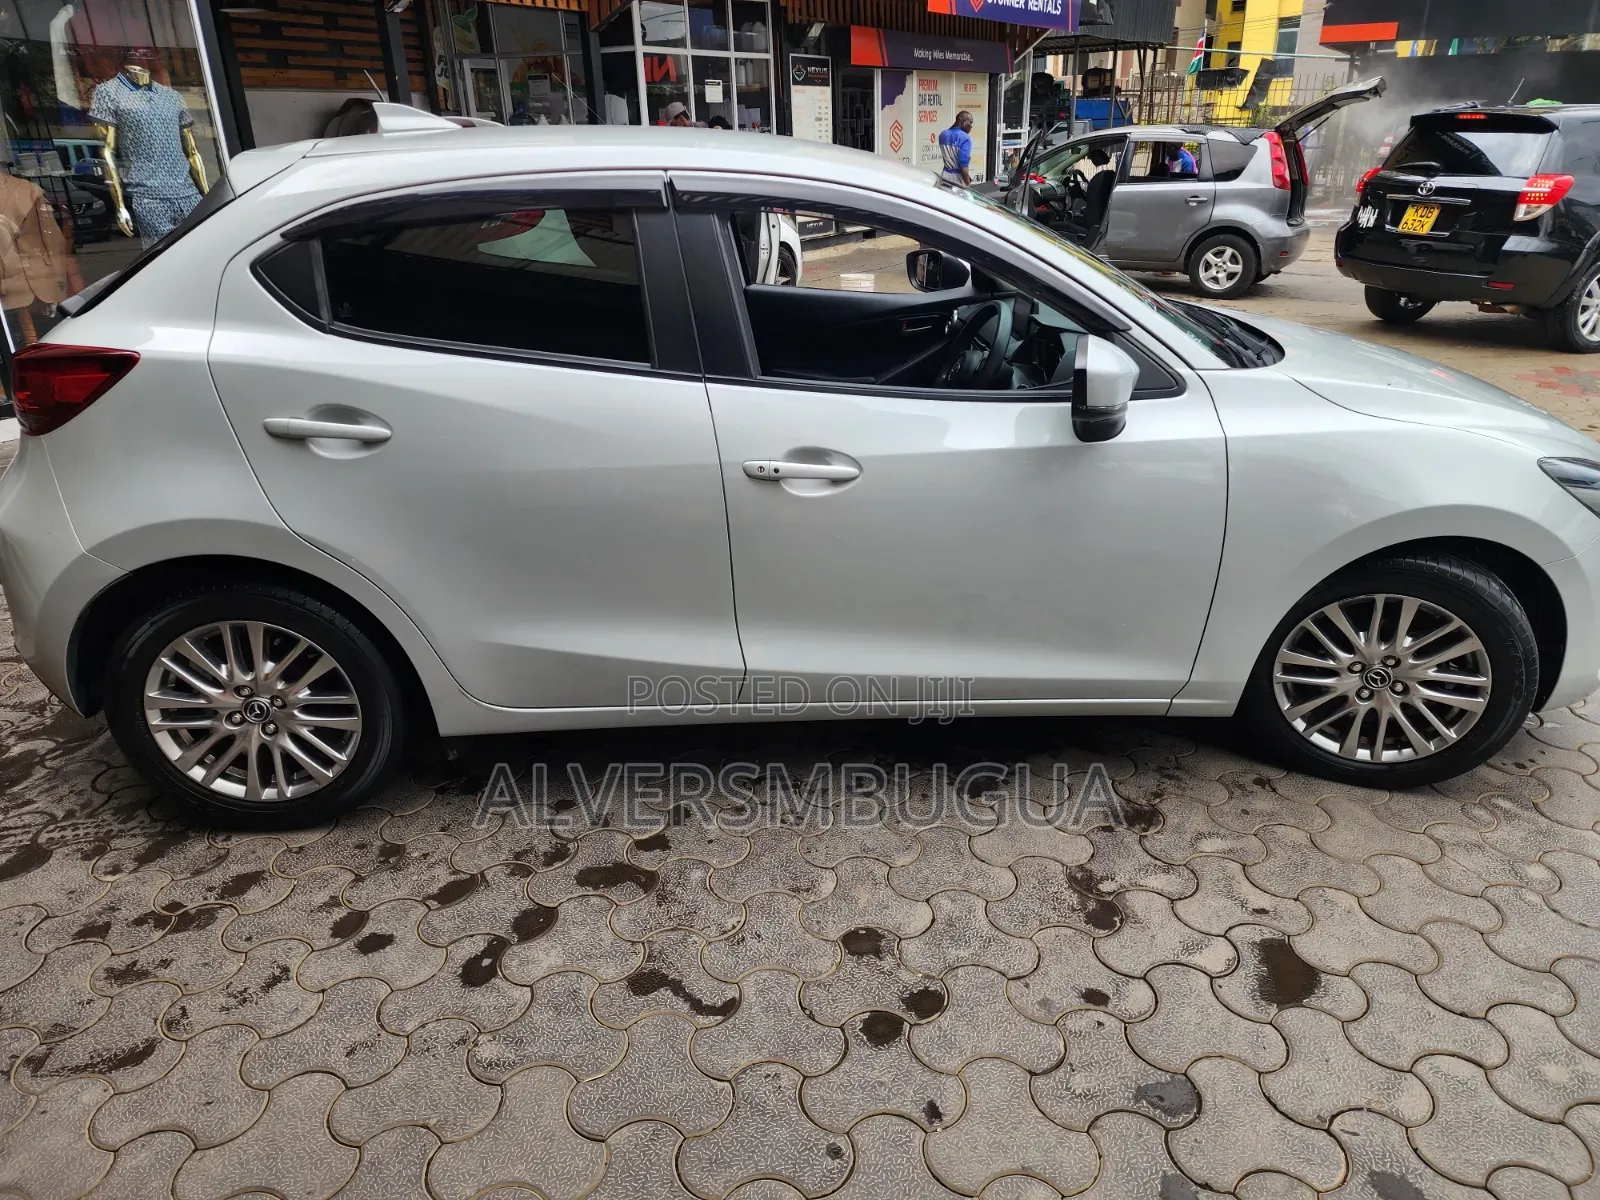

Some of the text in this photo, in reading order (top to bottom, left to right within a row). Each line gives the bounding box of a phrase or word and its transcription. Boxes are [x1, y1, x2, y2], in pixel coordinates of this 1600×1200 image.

[1028, 0, 1062, 15] RENTALS
[914, 48, 932, 61] Making
[807, 66, 828, 75] NEXUS
[918, 79, 938, 91] PREMIUM
[918, 93, 942, 106] CAR RENTAL
[918, 110, 938, 123] SERVICES
[1413, 204, 1436, 219] KDB
[1401, 218, 1428, 232] 632K
